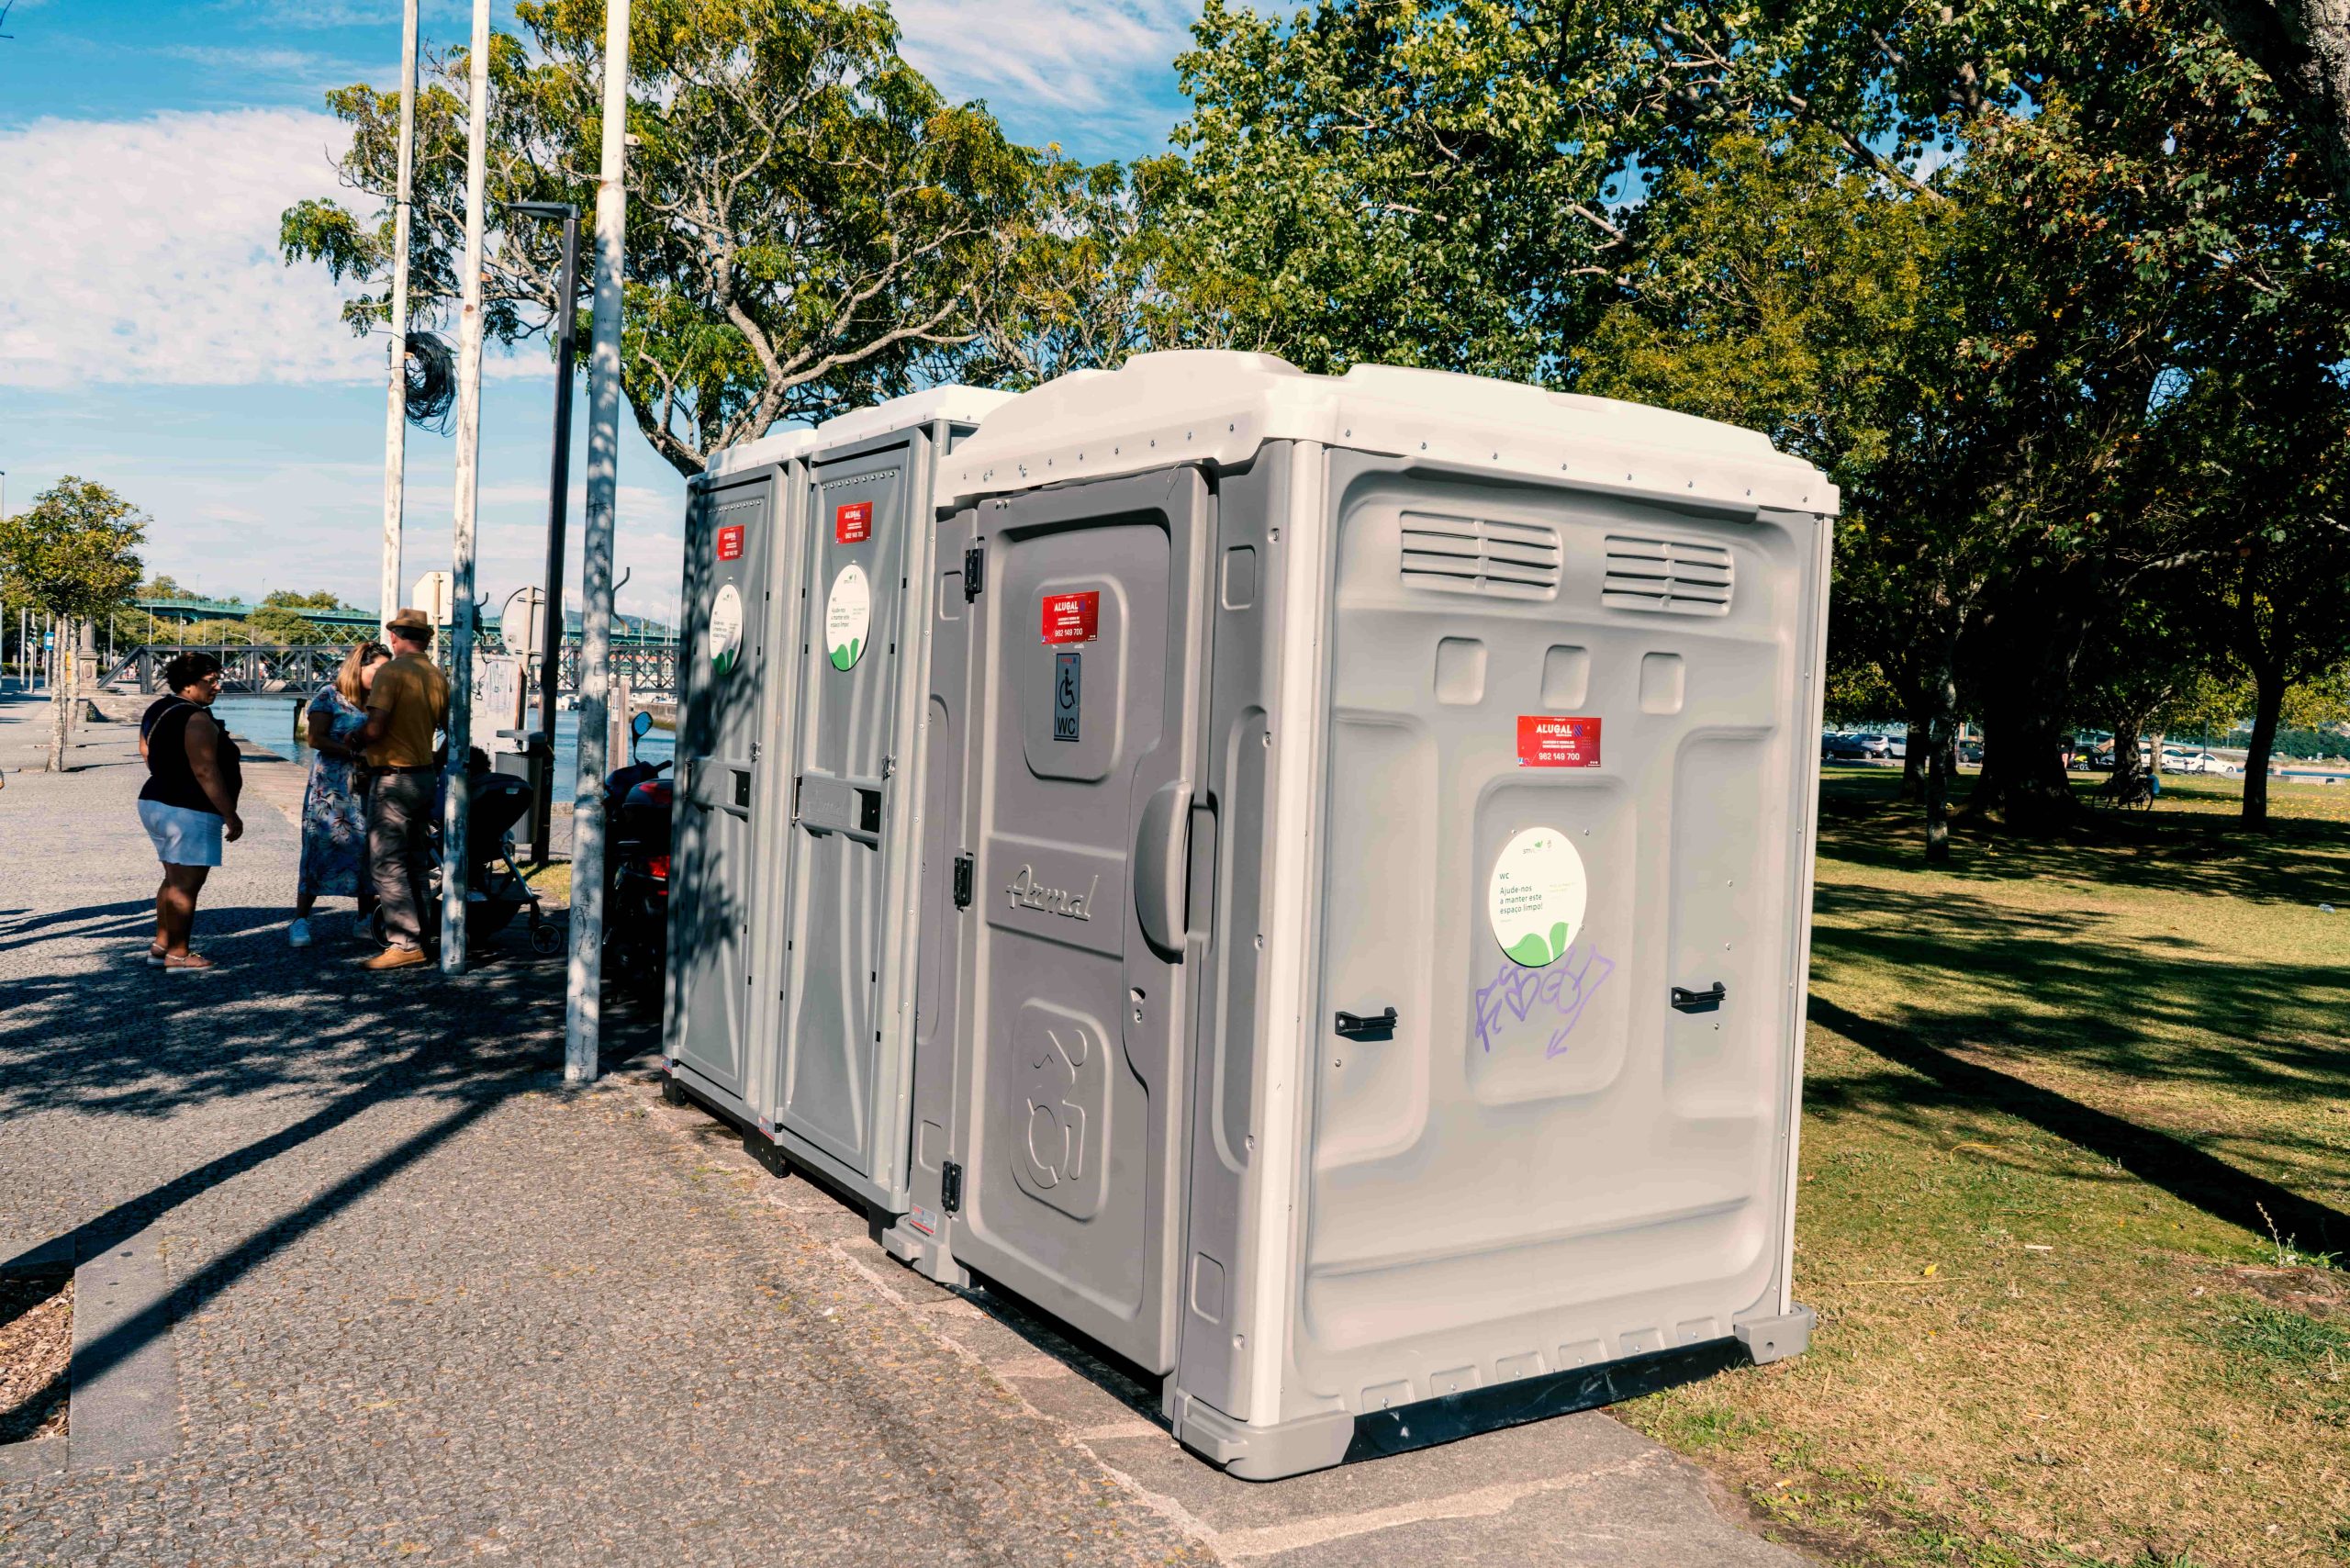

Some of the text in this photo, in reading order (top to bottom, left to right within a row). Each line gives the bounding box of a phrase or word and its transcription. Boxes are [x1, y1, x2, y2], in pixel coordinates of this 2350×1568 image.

[1054, 601, 1079, 612] ALUGAL
[1058, 717, 1076, 734] WC
[1536, 724, 1572, 734] ALUGAL
[1539, 752, 1551, 760] 962
[1553, 752, 1565, 760] 149
[1500, 885, 1532, 896] Ajude-nos
[1500, 902, 1543, 915] espaço limpo!
